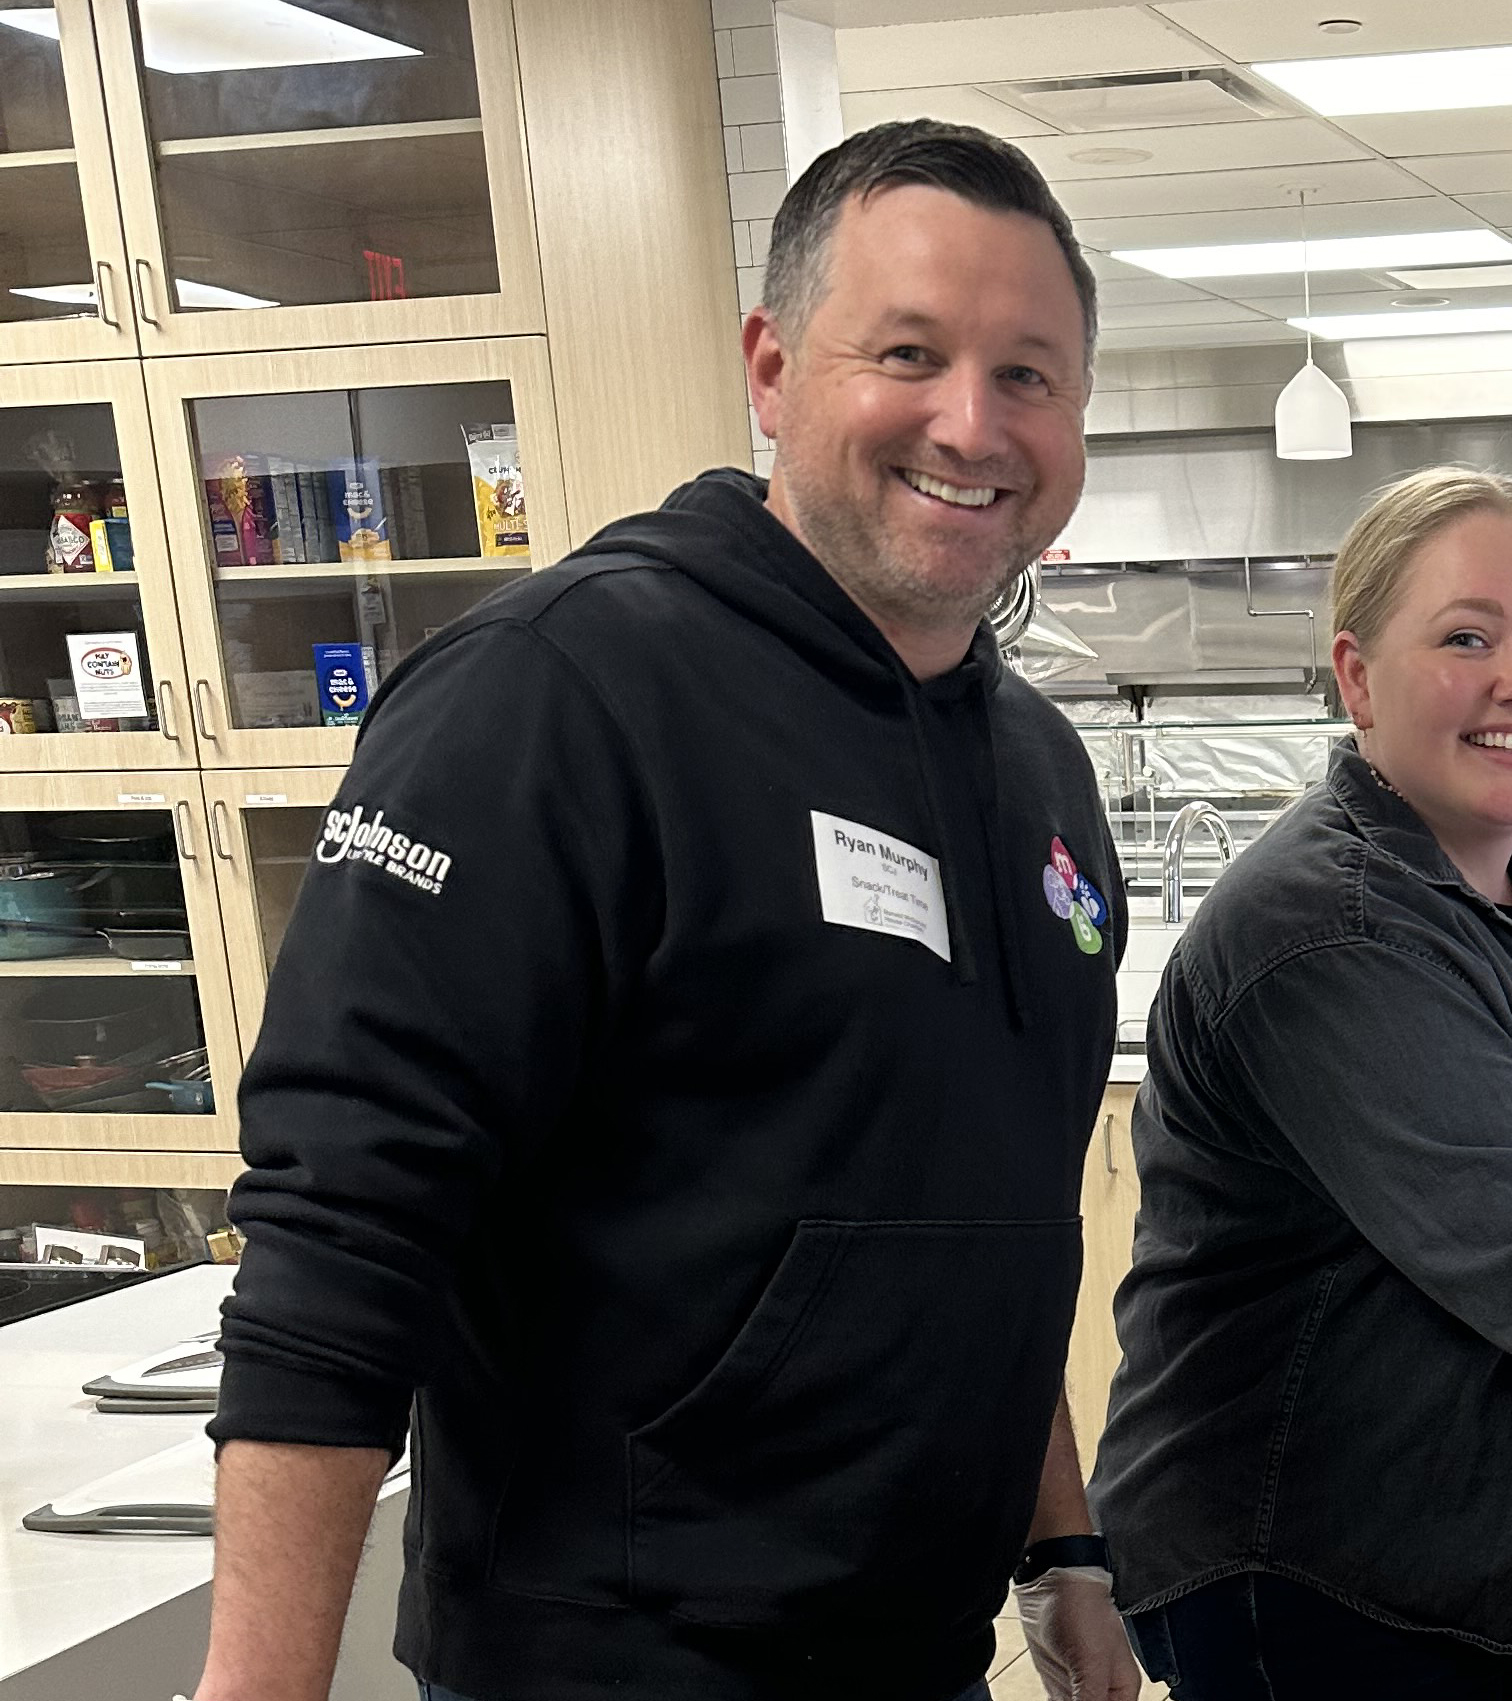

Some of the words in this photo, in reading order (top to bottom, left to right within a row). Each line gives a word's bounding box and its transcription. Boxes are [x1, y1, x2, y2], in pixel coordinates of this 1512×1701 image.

[834, 829, 876, 855] Ryan
[879, 844, 928, 881] Murphy
[384, 860, 443, 895] BRANDS
